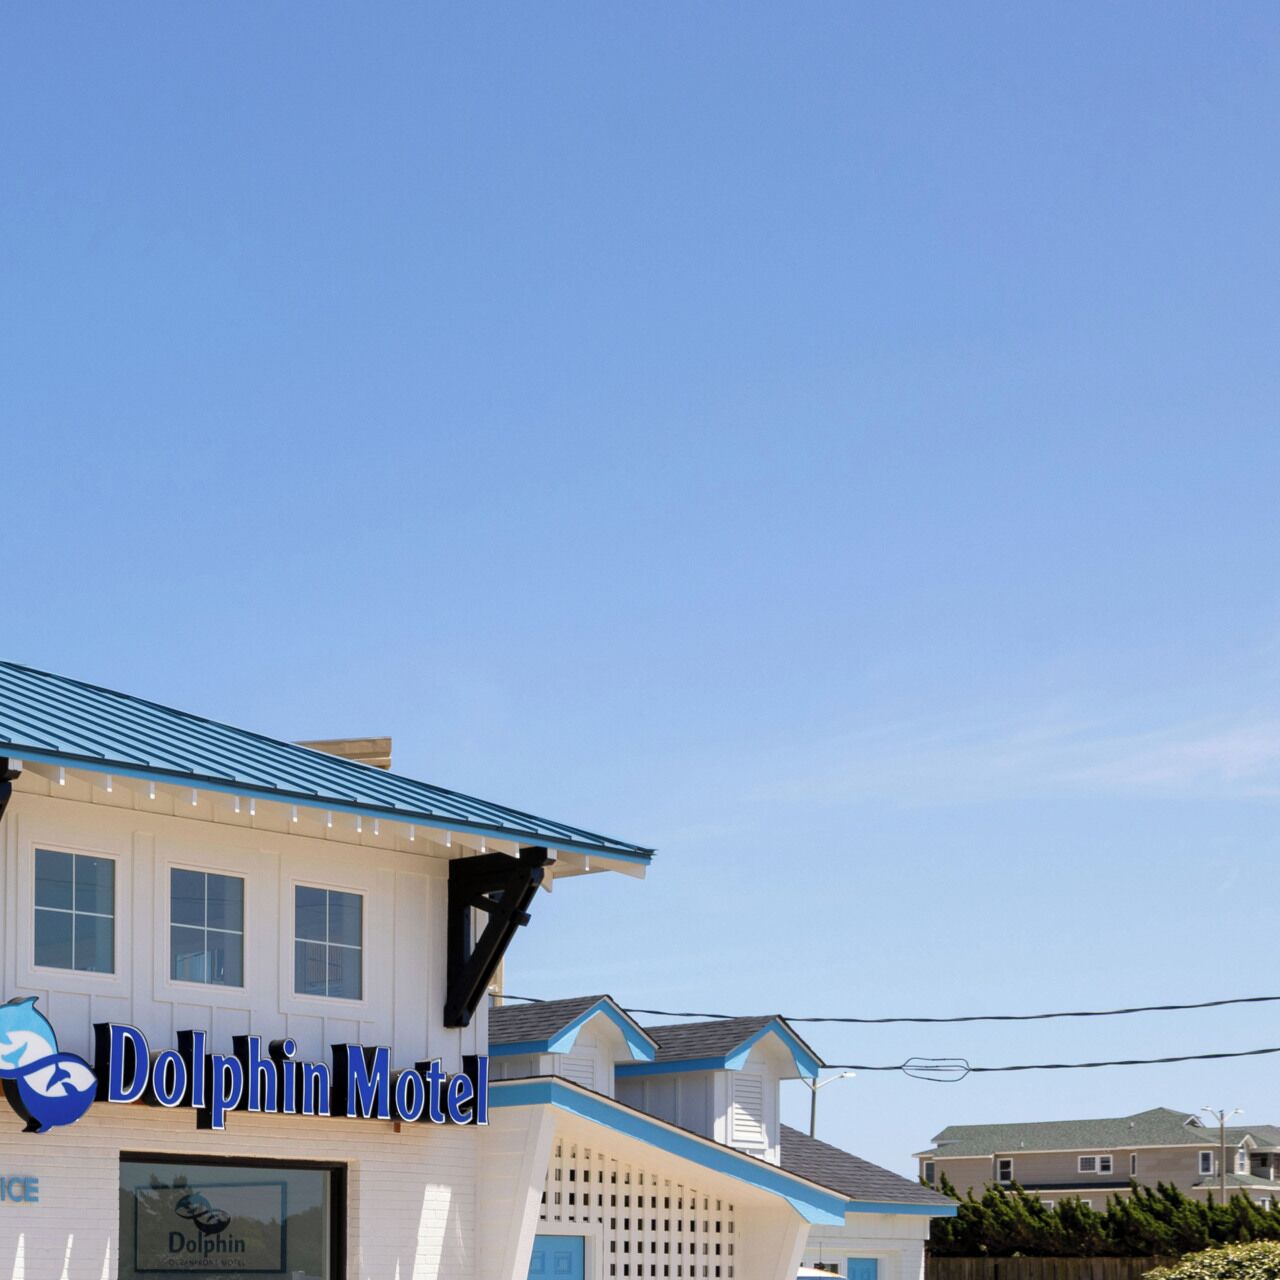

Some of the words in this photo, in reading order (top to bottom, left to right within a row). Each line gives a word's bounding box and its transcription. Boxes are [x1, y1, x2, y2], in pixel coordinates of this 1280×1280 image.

[102, 1023, 331, 1130] Dolphin
[342, 1043, 489, 1126] Motel
[168, 1231, 245, 1258] Dolphin
